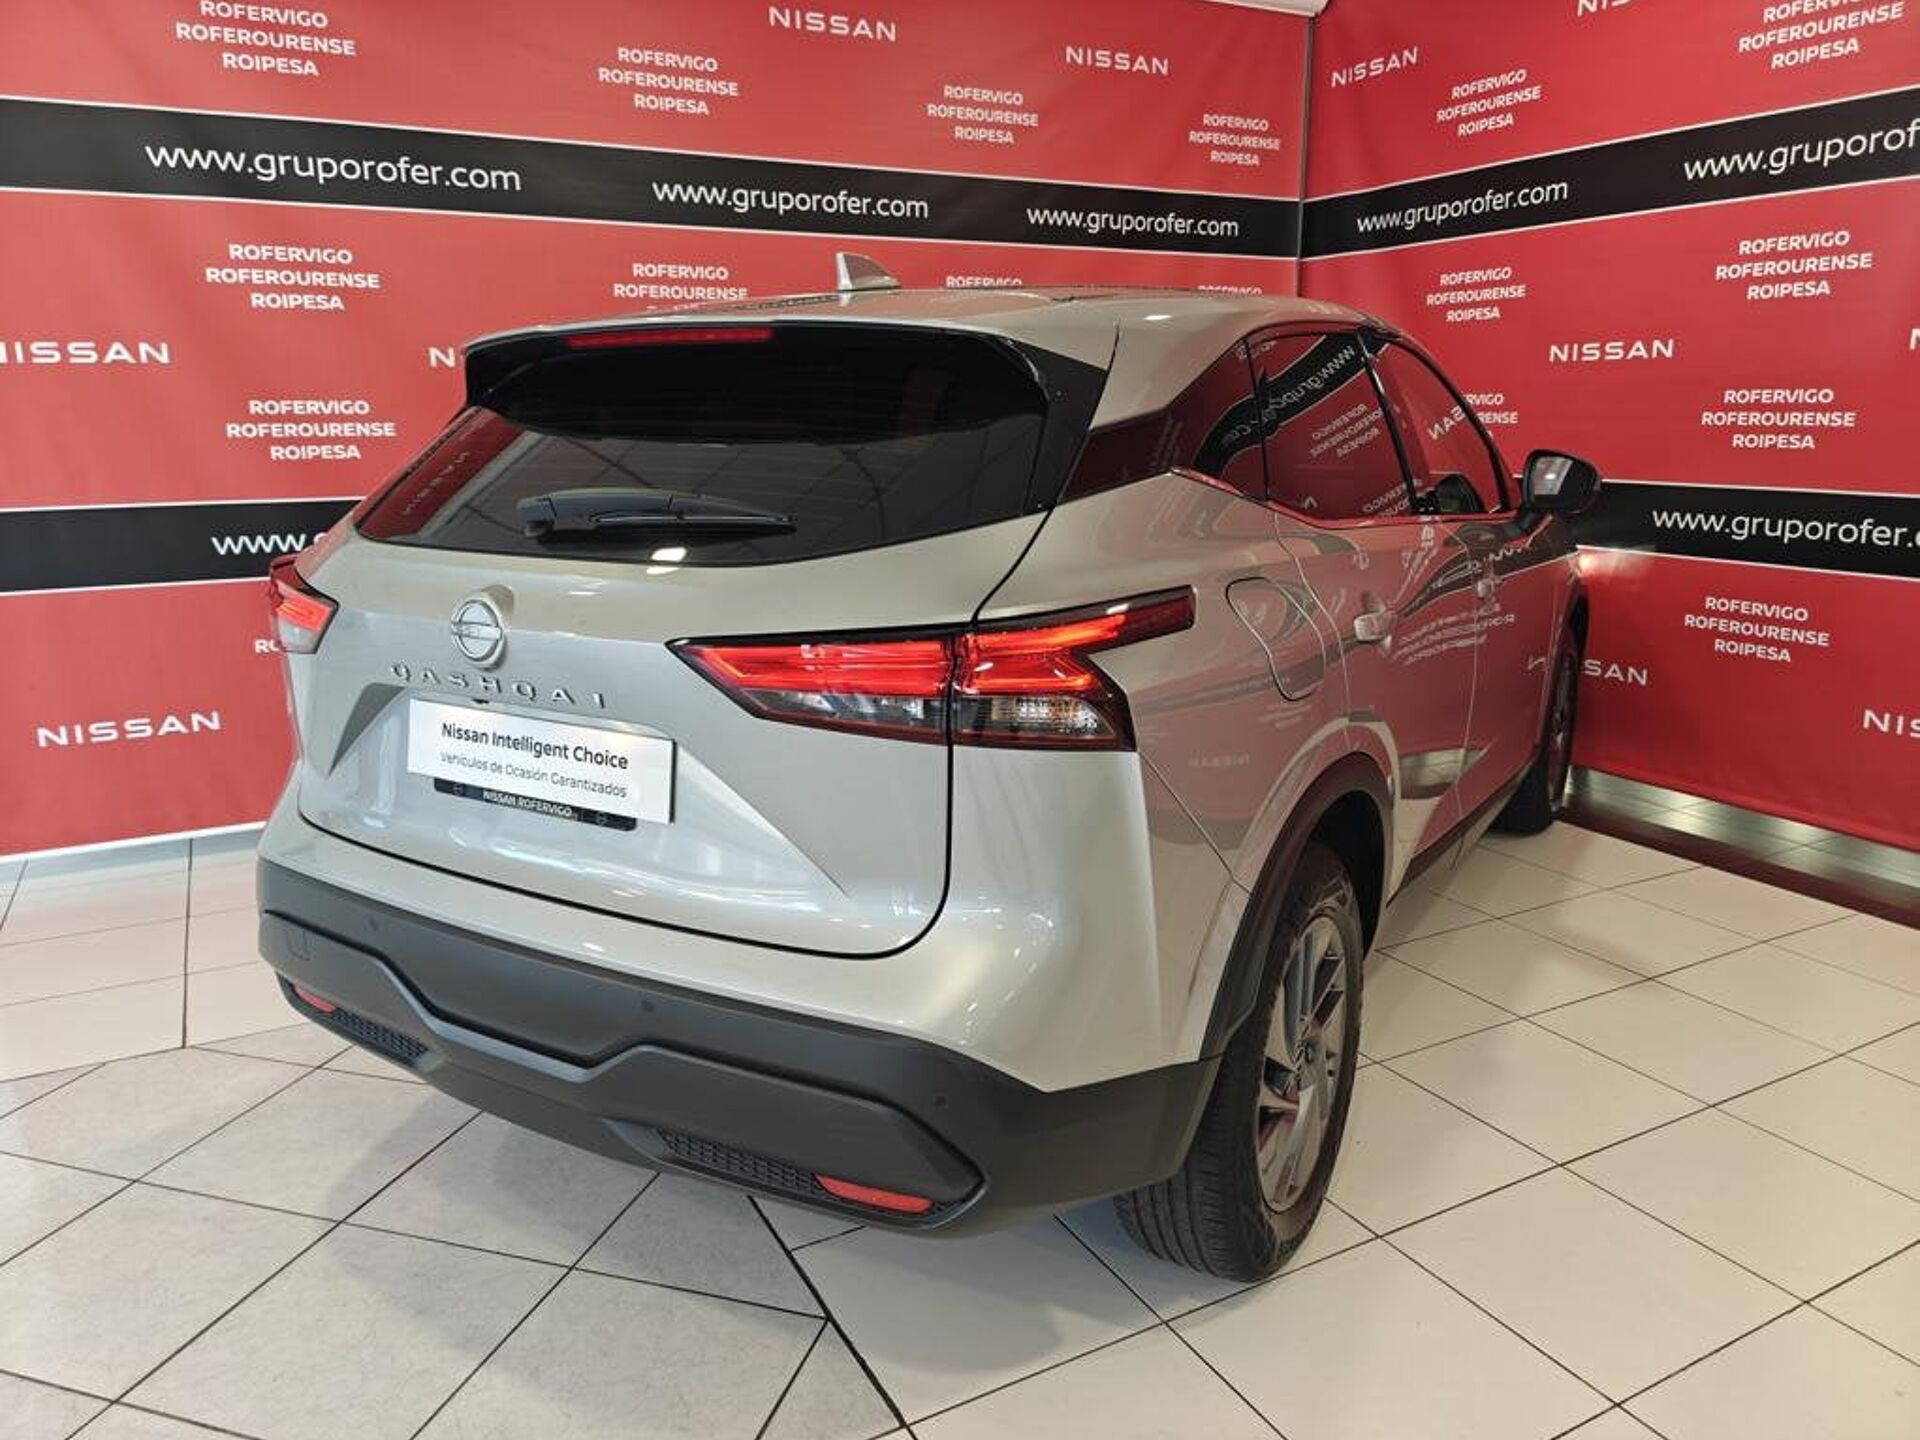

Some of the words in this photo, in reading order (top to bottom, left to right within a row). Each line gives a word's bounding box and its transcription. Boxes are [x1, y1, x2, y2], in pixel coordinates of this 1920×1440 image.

[201, 0, 327, 28] ROFERVIGO
[769, 7, 895, 41] NISSAN
[176, 22, 356, 56] ROFEROURENSE
[1739, 2, 1904, 52] ROFEROURENSE
[222, 52, 319, 76] ROIPESA
[617, 48, 718, 71] ROFERVIGO
[1066, 46, 1168, 74] NISSAN
[1771, 38, 1859, 69] ROIPESA
[1332, 47, 1417, 87] NISSAN
[598, 67, 739, 97] ROFEROURENSE
[1451, 68, 1527, 100] ROFERVIGO
[634, 94, 708, 114] ROIPESA
[943, 85, 1023, 106] ROFERVIGO
[1436, 85, 1542, 123] ROFEROURENSE
[927, 105, 1038, 127] ROFEROURENSE
[1203, 114, 1268, 131] ROFERVIGO
[1458, 113, 1514, 137] ROIPESA
[955, 126, 1013, 143] ROIPESA
[1189, 131, 1280, 150] ROFEROURENSE
[145, 145, 521, 191] www.gruporofer.com
[1211, 150, 1259, 165] ROIPESA
[652, 183, 928, 218] www.gruporofer.com
[1356, 180, 1568, 233] www.gruporofer.com
[1027, 209, 1238, 236] www.gruporofer.com
[229, 244, 352, 263] ROFERVIGO
[1739, 231, 1850, 255] ROFERVIGO
[206, 268, 379, 288] ROFEROURENSE
[633, 263, 728, 280] ROFERVIGO
[1440, 267, 1512, 286] ROFERVIGO
[1715, 252, 1873, 280] ROFEROURENSE
[251, 293, 343, 309] ROIPESA
[614, 284, 747, 300] ROFEROURENSE
[1427, 285, 1526, 305] ROFEROURENSE
[1747, 281, 1830, 299] ROIPESA
[1447, 307, 1500, 321] ROIPESA
[1550, 339, 1673, 362] NISSAN
[250, 401, 369, 414] ROFERVIGO
[1724, 389, 1833, 403] ROFERVIGO
[227, 423, 394, 437] ROFEROURENSE
[1702, 412, 1856, 426] ROFEROURENSE
[271, 445, 360, 459] ROIPESA
[1733, 434, 1815, 448] ROIPESA
[1705, 596, 1808, 621] ROFERVIGO
[1684, 614, 1830, 646] ROFEROURENSE
[1714, 638, 1791, 662] ROIPESA
[1585, 660, 1647, 685] SAN
[390, 663, 606, 708] QASHQAI
[37, 712, 219, 747] NISSAN
[441, 723, 489, 744] Nissan
[492, 733, 569, 758] Intelligent
[573, 746, 629, 769] Choice
[490, 762, 502, 773] de
[505, 763, 548, 781] Ocasión
[550, 772, 627, 798] Garantizados
[483, 790, 515, 805] NISSAN
[518, 797, 572, 816] ROFERVIGO
